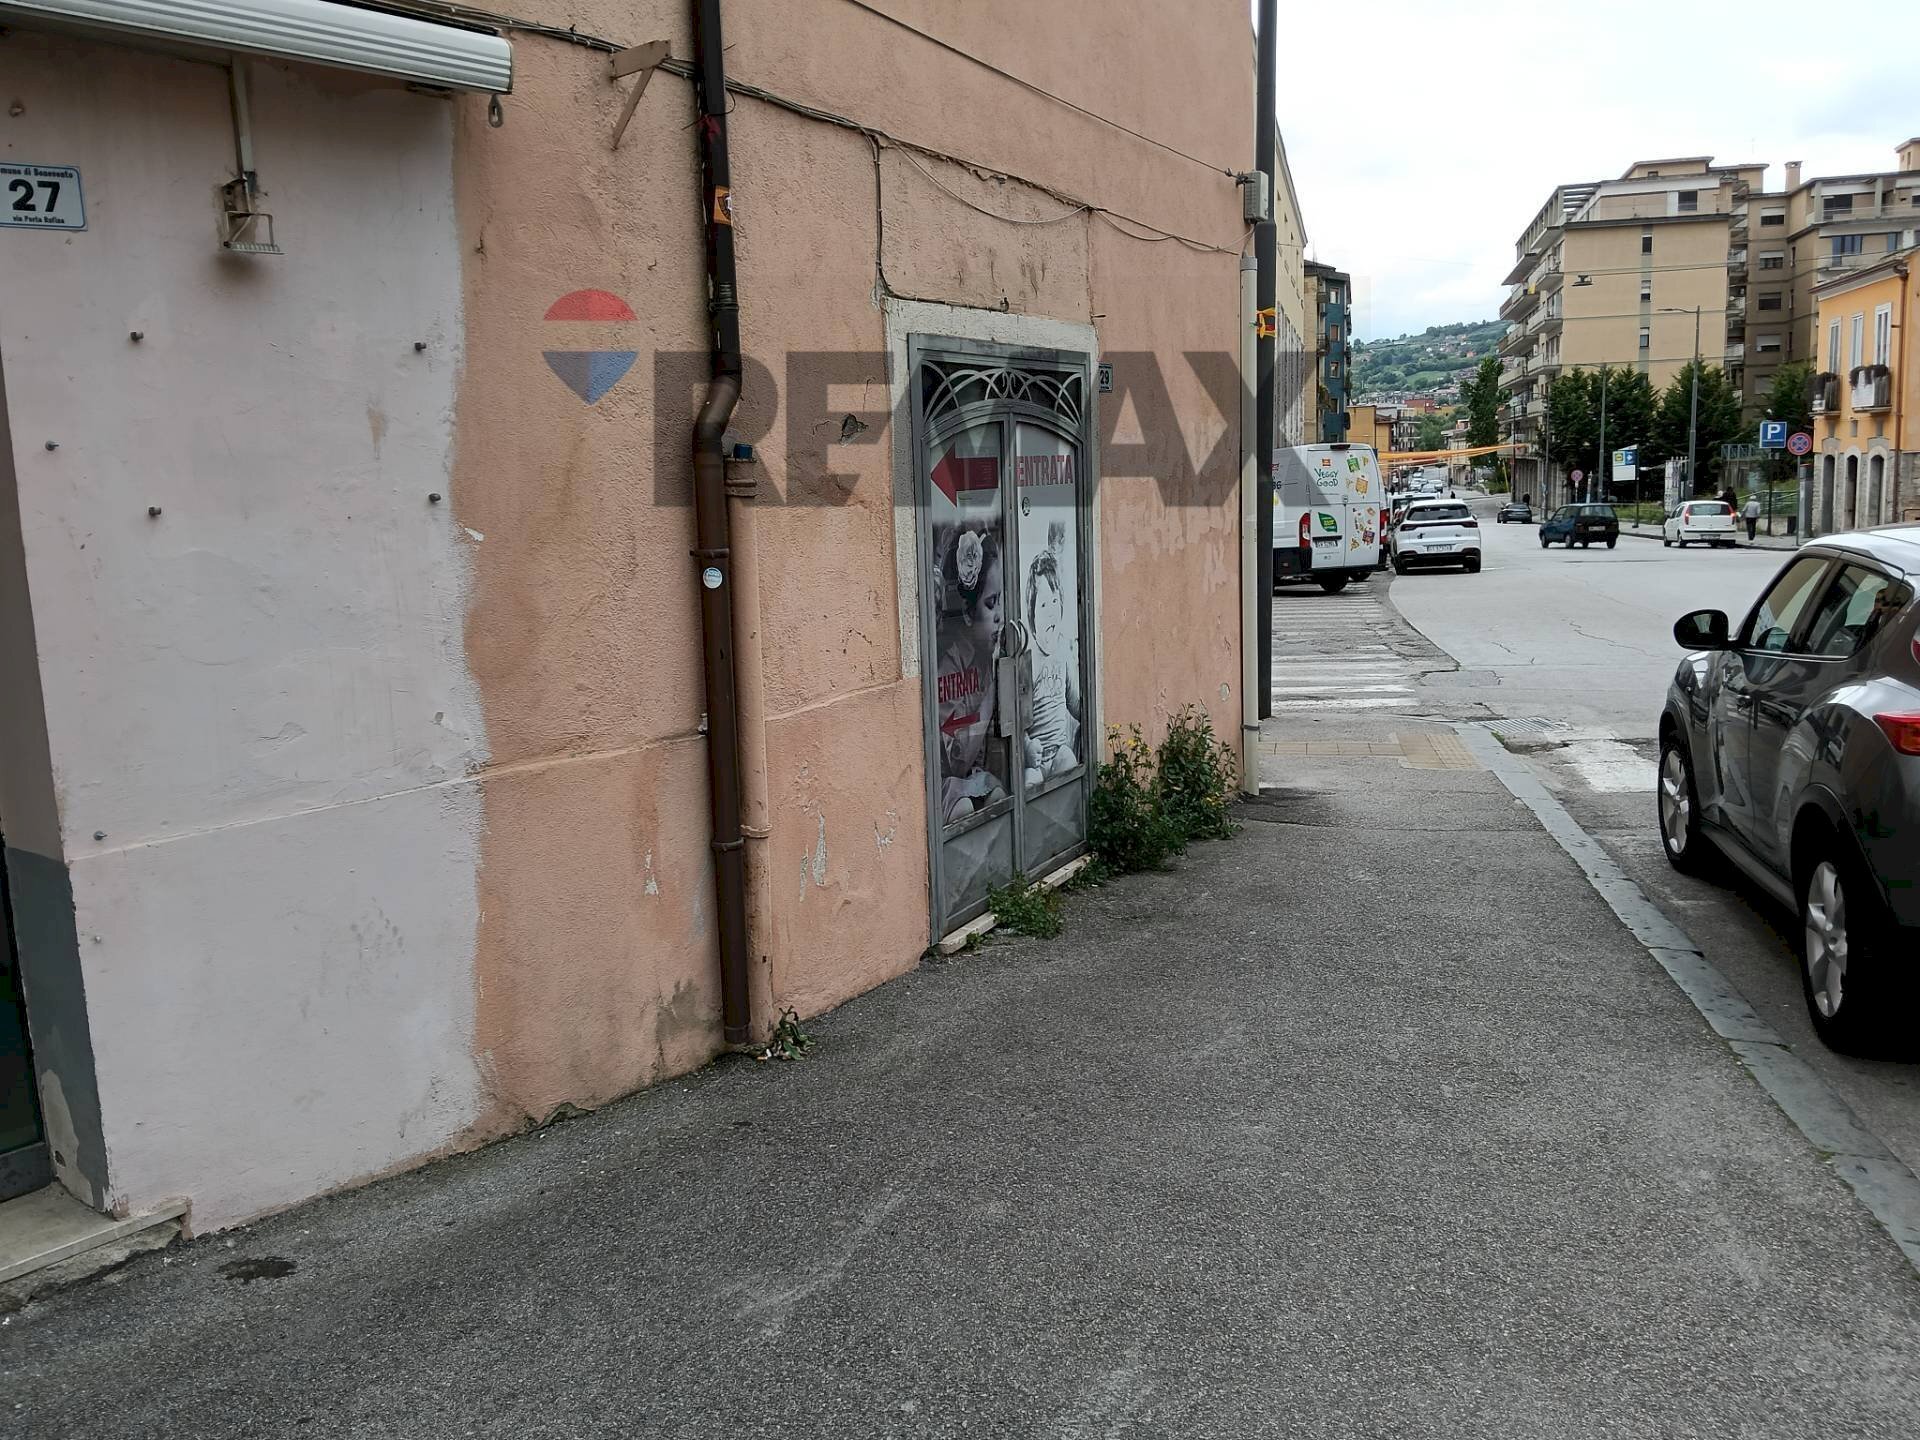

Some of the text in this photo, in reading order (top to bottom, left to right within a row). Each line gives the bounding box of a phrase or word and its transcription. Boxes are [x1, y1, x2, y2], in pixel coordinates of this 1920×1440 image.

[9, 179, 60, 212] 27
[1100, 370, 1110, 385] 29
[1767, 424, 1781, 440] P
[1017, 454, 1073, 487] ENTRATA
[937, 667, 980, 704] ENTRATA
